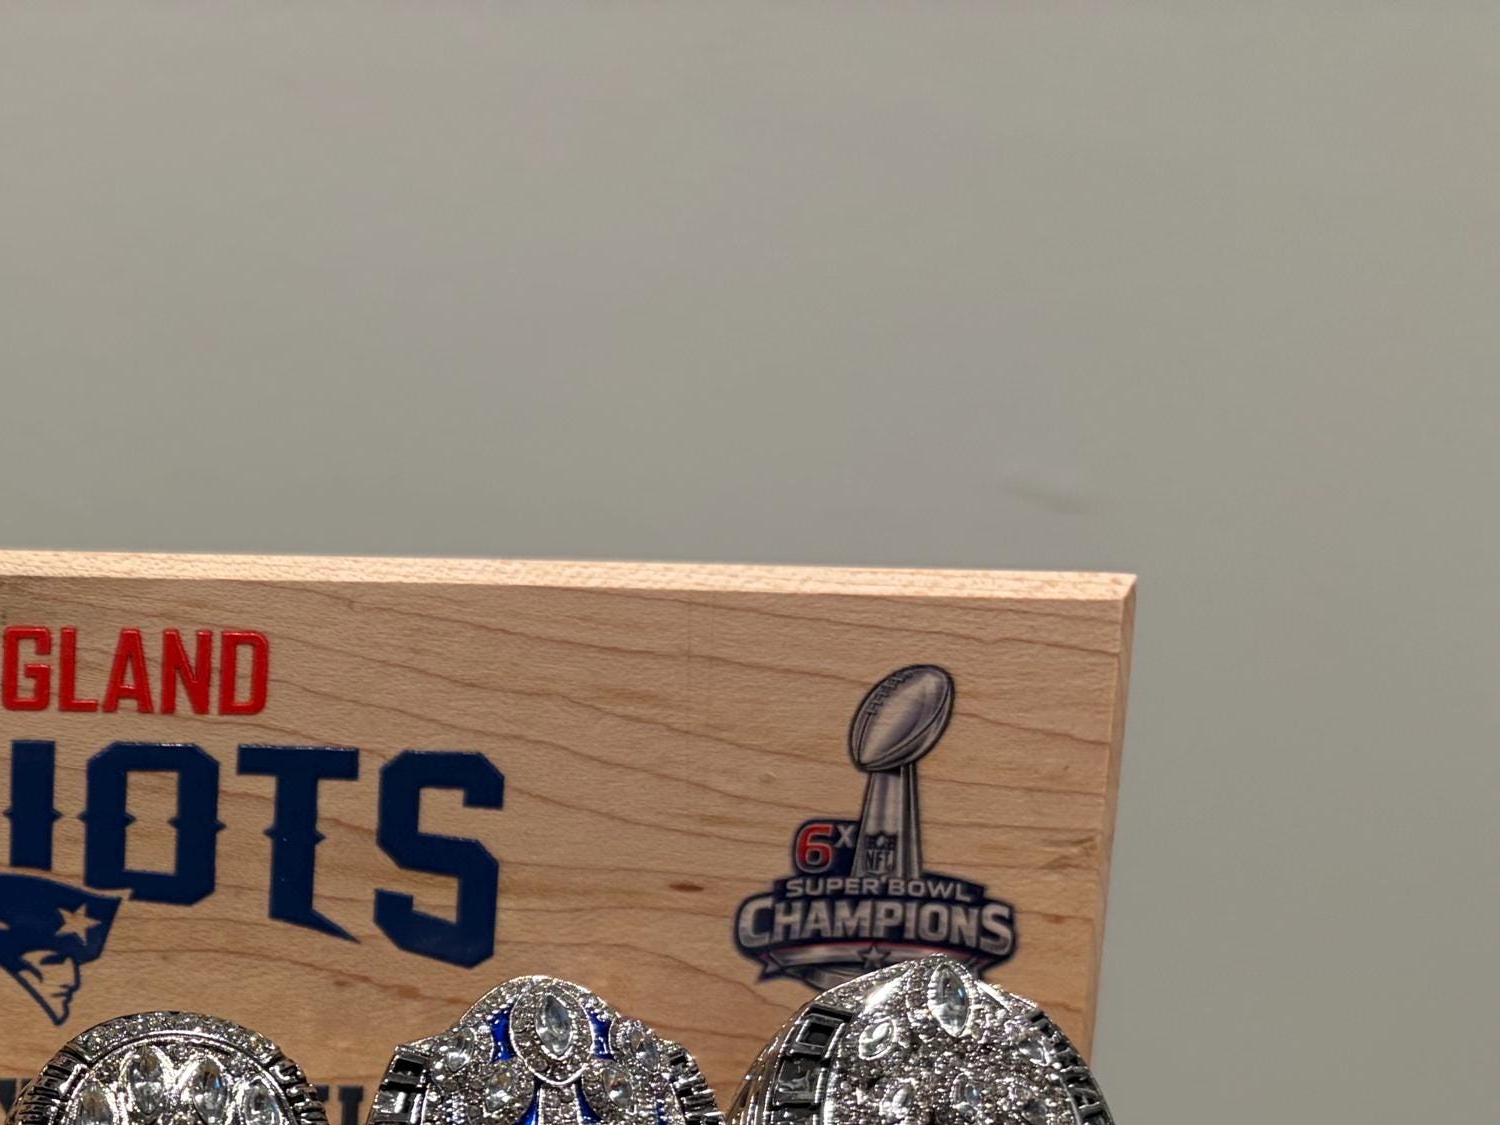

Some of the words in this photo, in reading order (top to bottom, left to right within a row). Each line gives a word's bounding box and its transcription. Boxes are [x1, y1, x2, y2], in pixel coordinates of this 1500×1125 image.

[785, 877, 880, 897] SUPER
[887, 878, 972, 902] BOWL
[738, 898, 1014, 954] CHAMPIONS
